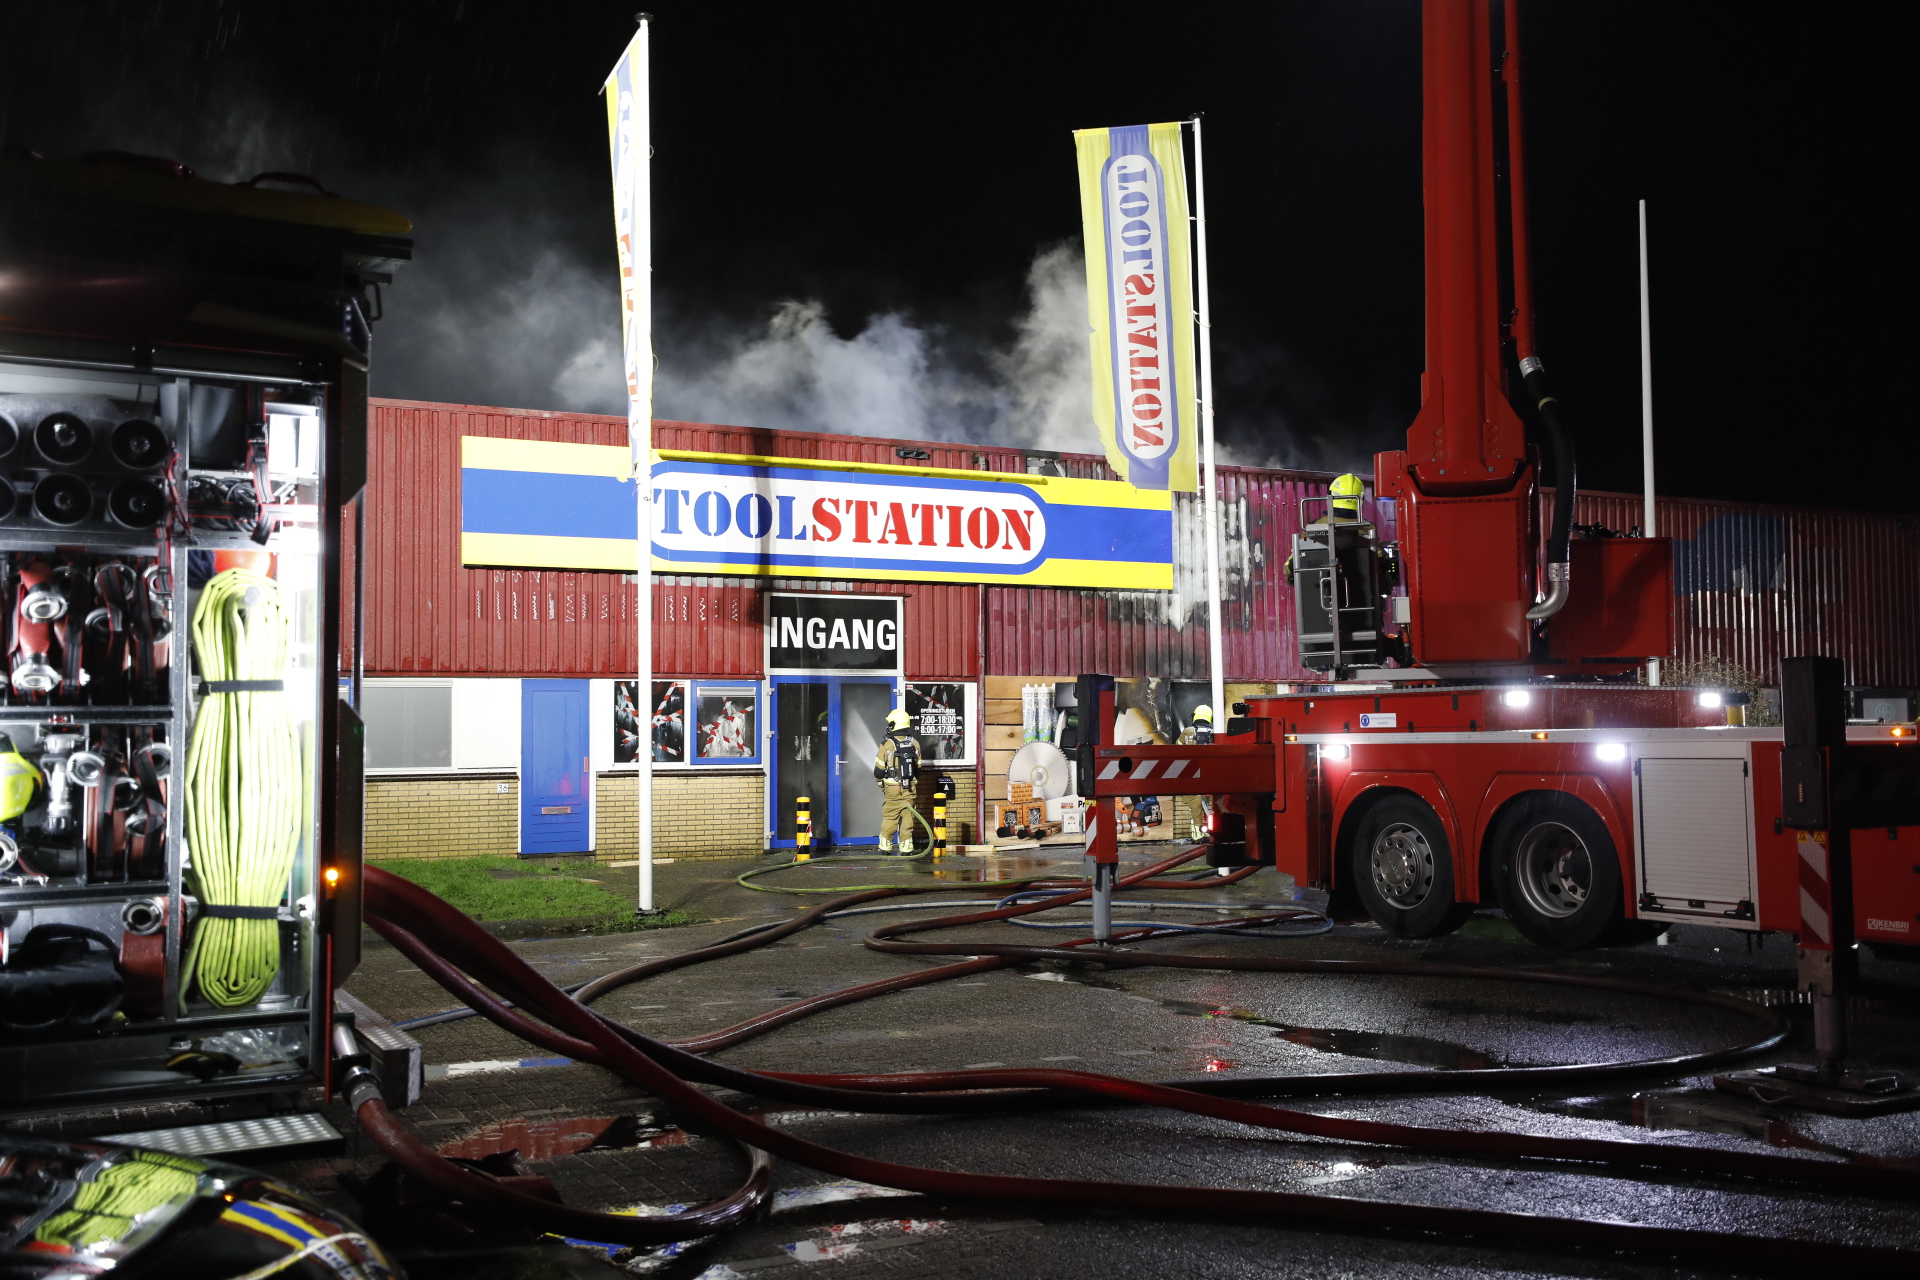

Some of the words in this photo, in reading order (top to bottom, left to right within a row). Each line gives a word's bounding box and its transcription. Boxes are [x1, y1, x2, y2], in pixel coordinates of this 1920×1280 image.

[653, 488, 1034, 551] TOOLSTATION
[770, 616, 896, 650] INGANG
[921, 715, 956, 724] 7:00-18:00
[921, 725, 956, 734] 8:00-17:00
[498, 784, 508, 792] 36
[1878, 920, 1909, 929] KENBRI
